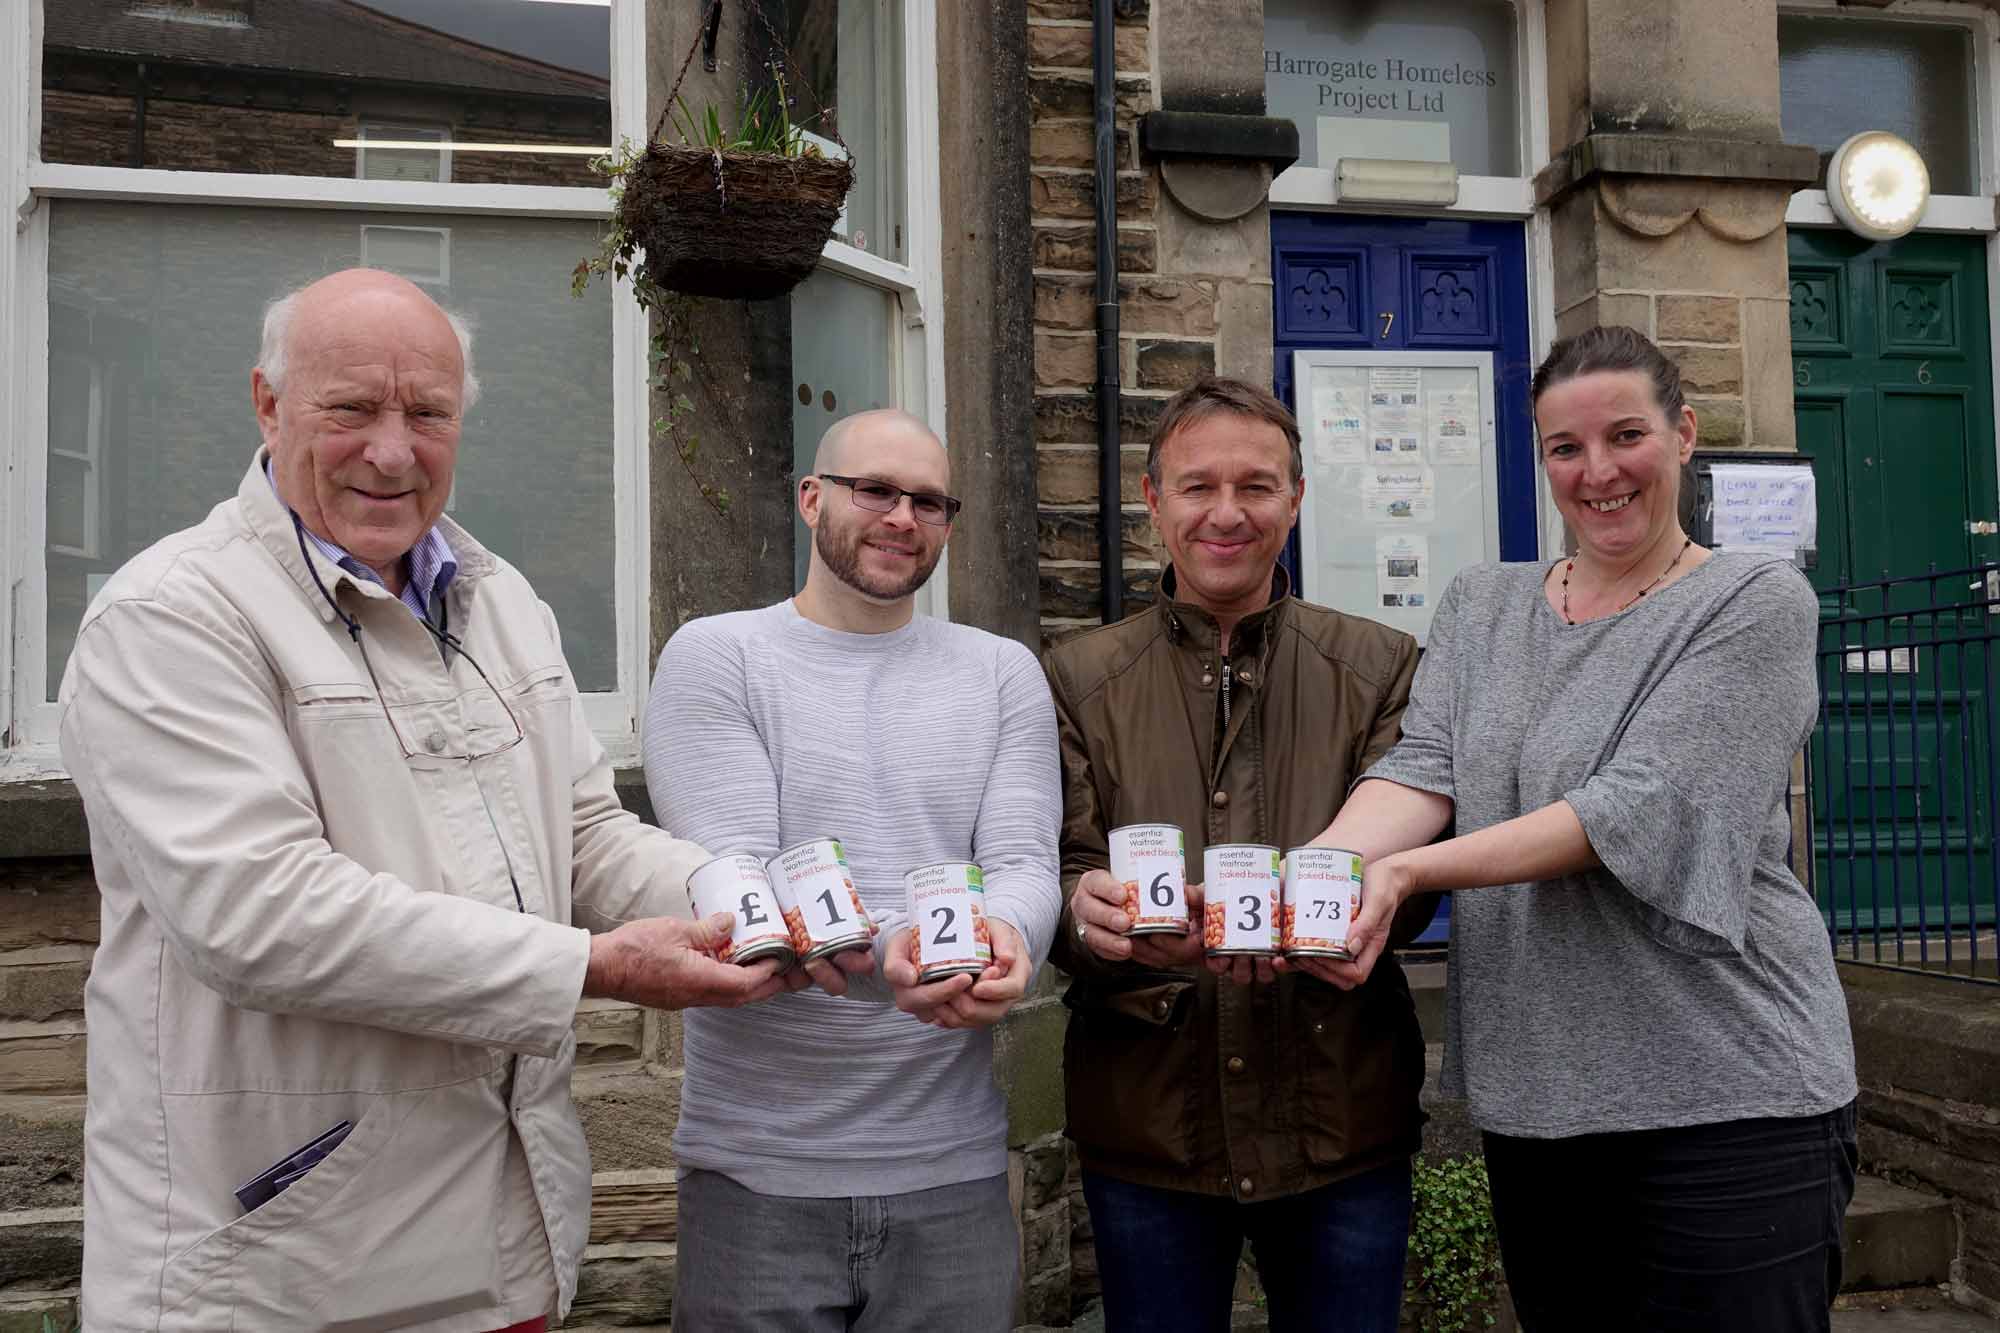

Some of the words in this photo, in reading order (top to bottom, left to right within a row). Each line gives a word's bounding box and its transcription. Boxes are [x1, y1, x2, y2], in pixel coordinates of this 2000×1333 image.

[1264, 50, 1377, 82] Harrogate
[1384, 58, 1497, 87] Homeless
[1317, 84, 1399, 114] Project
[1407, 89, 1444, 113] Ltd
[1379, 312, 1393, 339] 7
[1795, 361, 1811, 385] 5
[1918, 361, 1932, 385] 6
[1129, 830, 1163, 839] essential
[1129, 838, 1163, 847] Waitrose
[782, 846, 816, 865] essential
[1130, 848, 1157, 858] baked
[1219, 850, 1254, 859] essential
[1298, 853, 1333, 861] essential
[783, 856, 818, 873] Waitrose
[912, 866, 945, 881] essential
[1298, 862, 1333, 870] Waitrose
[913, 876, 946, 889] Waitrose
[1219, 871, 1248, 880] baked
[1249, 871, 1271, 880] beans
[1297, 872, 1325, 881] baked
[940, 885, 968, 897] beans
[1150, 872, 1175, 907] 6
[739, 891, 769, 927] £
[815, 888, 847, 927] 1
[1237, 895, 1262, 931] 3
[1305, 900, 1341, 920] .73
[931, 907, 957, 945] 2
